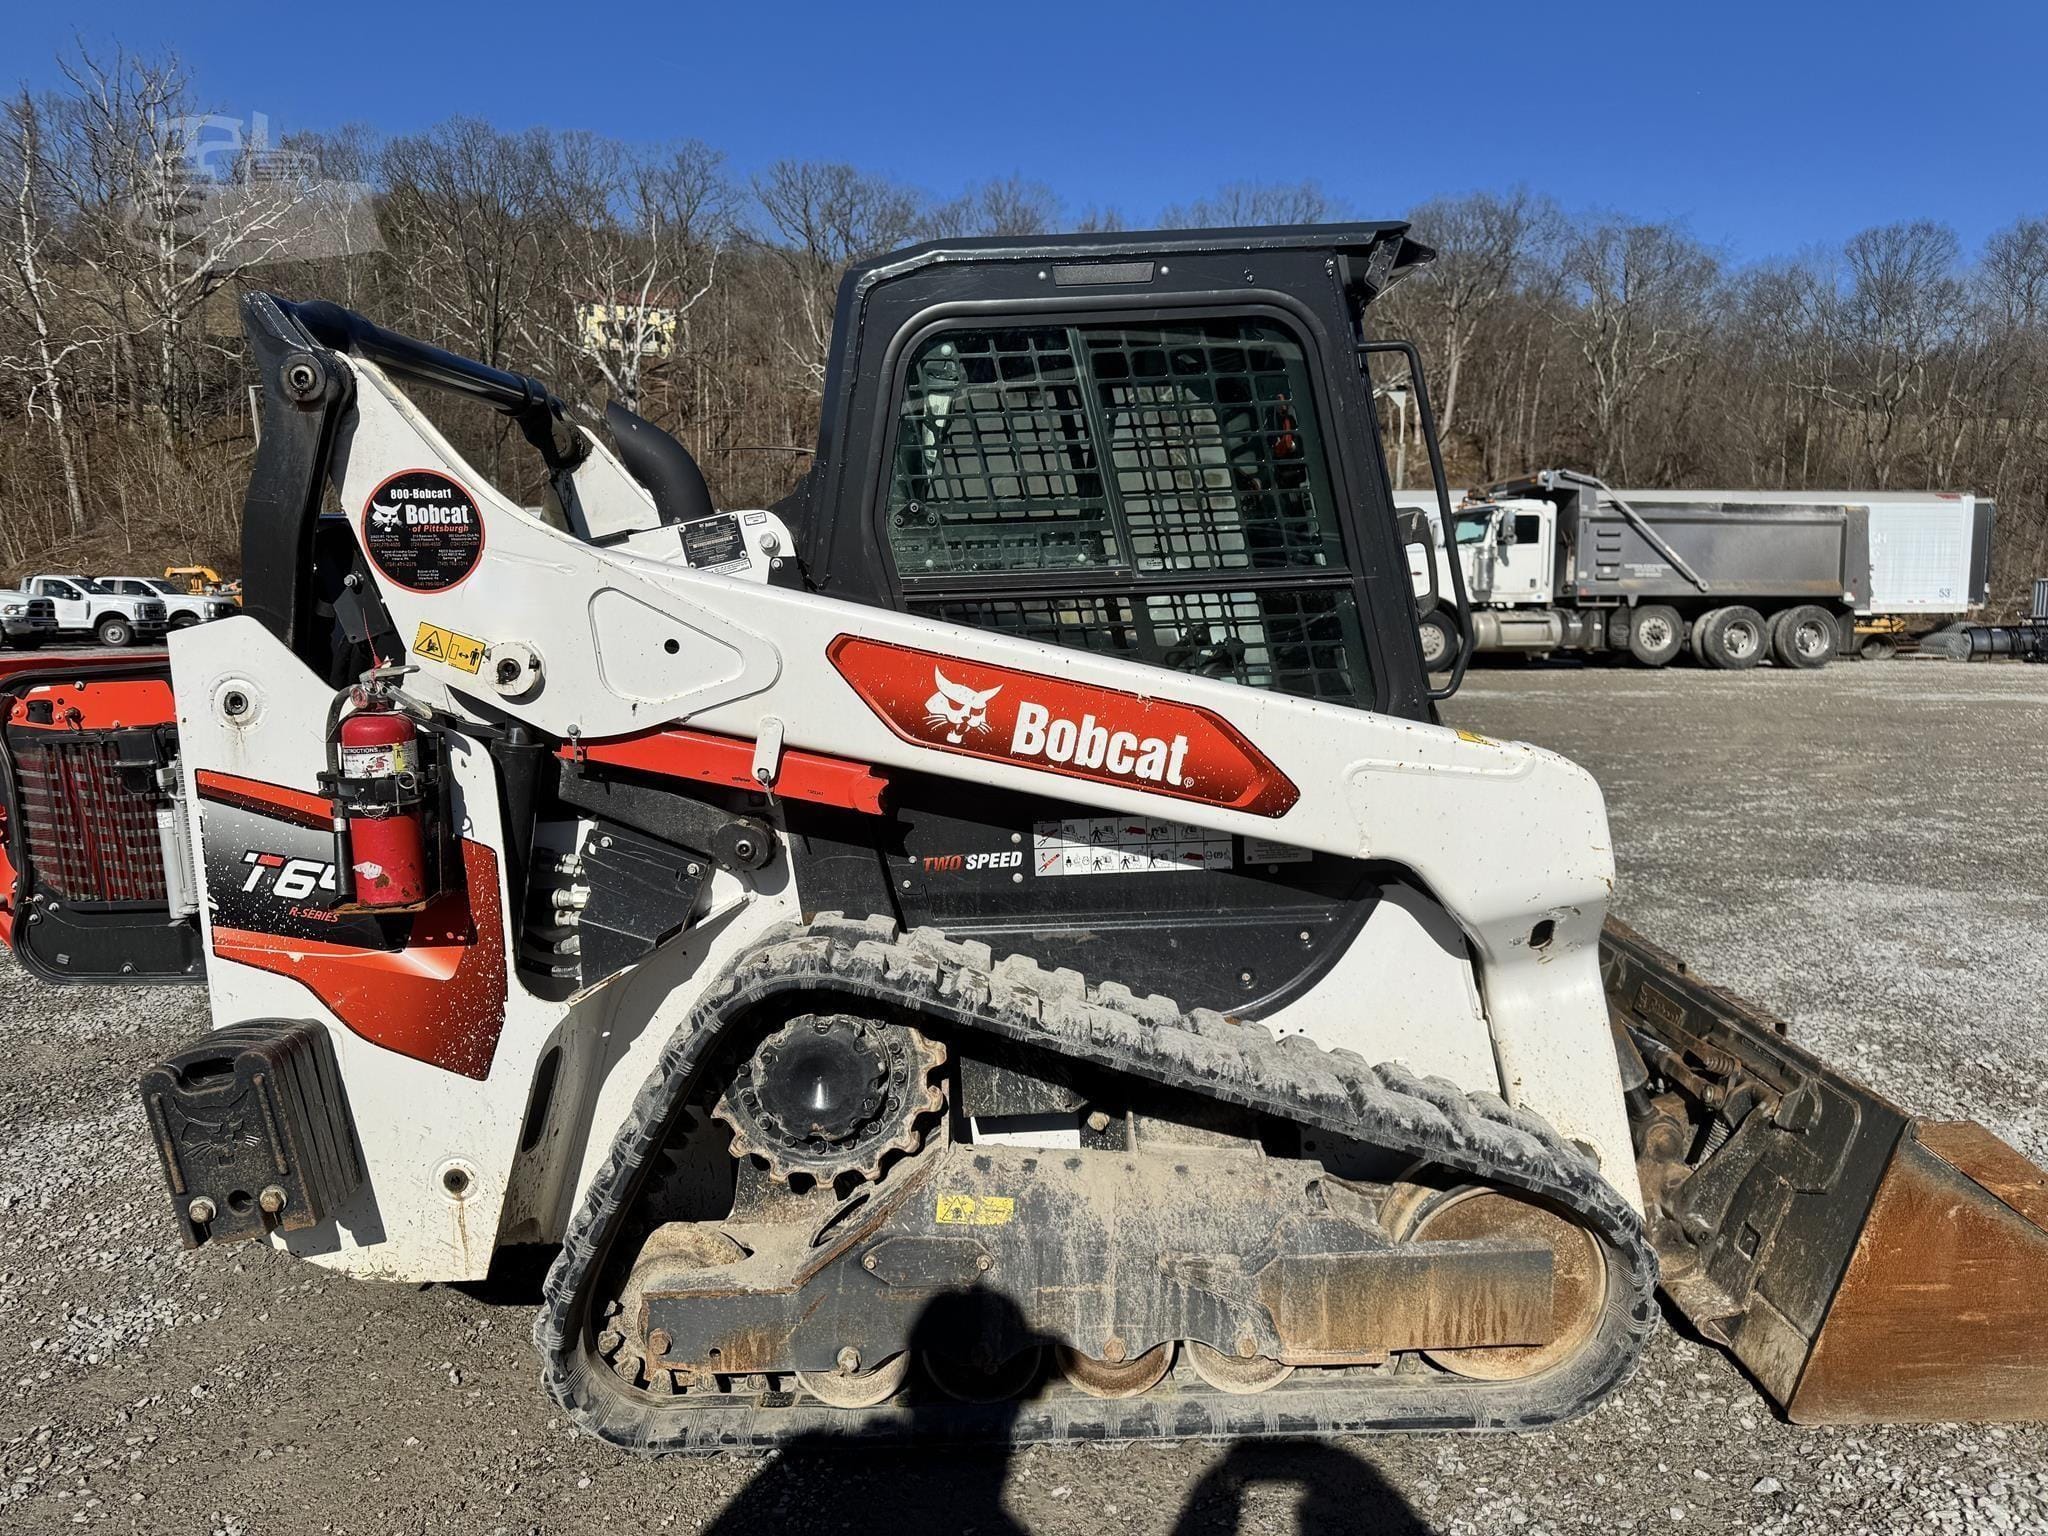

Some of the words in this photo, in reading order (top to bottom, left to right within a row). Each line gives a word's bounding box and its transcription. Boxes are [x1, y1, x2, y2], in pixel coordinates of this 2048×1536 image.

[390, 488, 452, 500] 800-Bobcat1
[405, 503, 470, 525] Bobcat
[412, 525, 422, 533] of
[423, 525, 469, 534] Pittsburgh
[1010, 700, 1190, 787] Bobcat
[923, 854, 963, 872] TWO
[965, 851, 1023, 871] SPEED
[288, 906, 341, 923] R-SERIES
